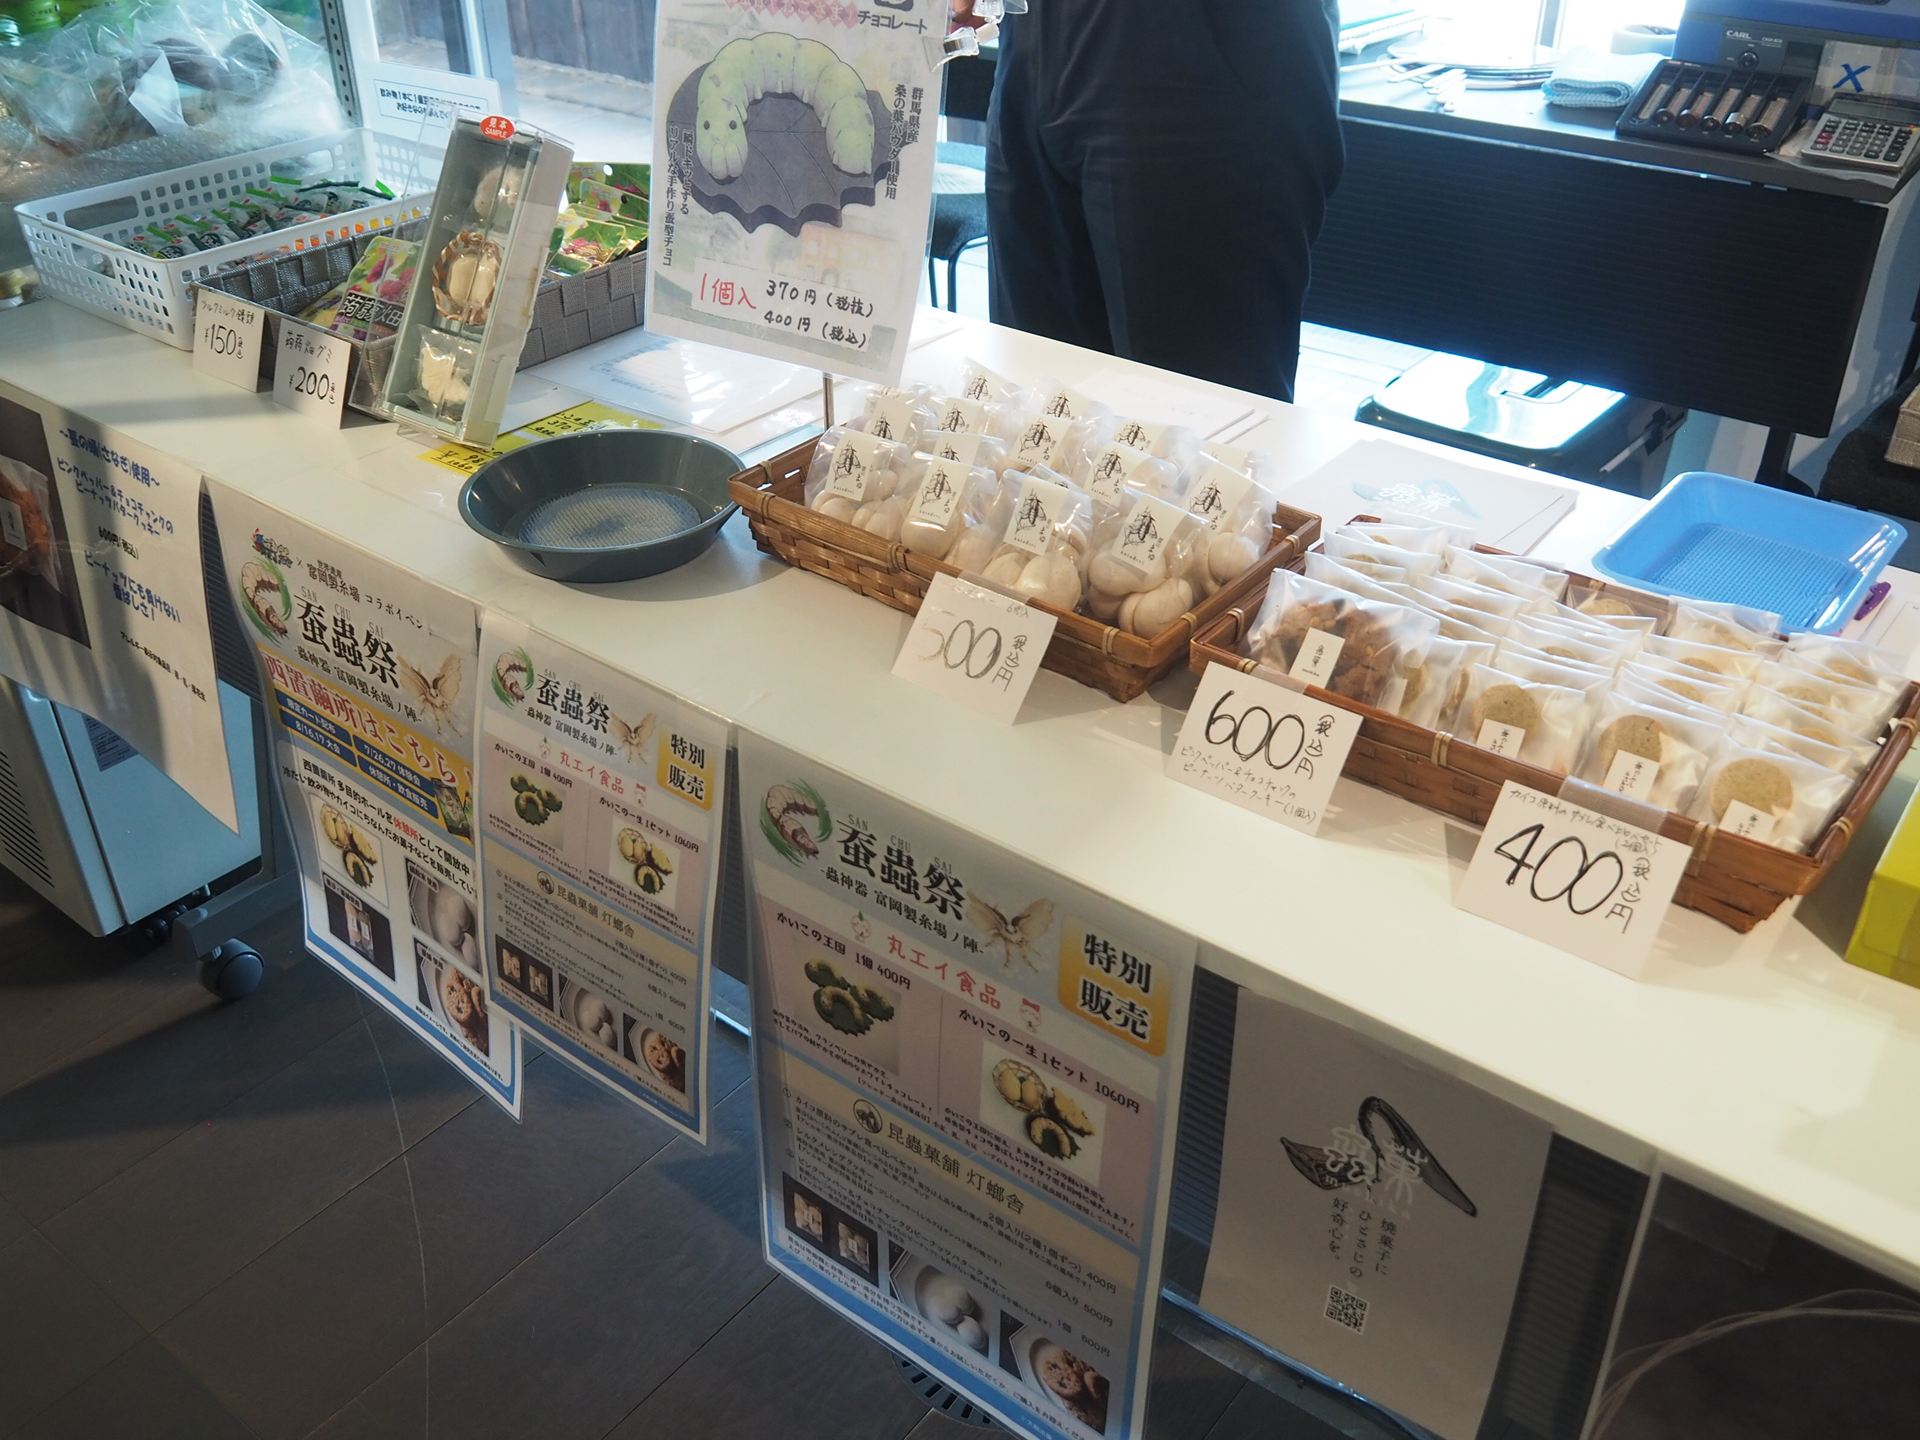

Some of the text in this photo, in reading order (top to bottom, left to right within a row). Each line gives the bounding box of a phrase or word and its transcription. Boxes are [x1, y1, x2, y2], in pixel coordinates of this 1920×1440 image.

[857, 9, 928, 35] チョコレート
[1726, 29, 1752, 40] CARL
[485, 127, 508, 139] SAMPLE
[488, 117, 507, 130] 見本
[885, 83, 907, 200] 桑の葉パウダー使用
[905, 86, 924, 143] 群馬県産
[662, 126, 679, 267] リアルな手作り蚕型チョコ
[680, 128, 694, 216] 一瞬ドキッとする
[766, 279, 817, 307] 370円
[826, 291, 874, 318] (税抜)
[204, 323, 237, 356] ¥150
[763, 310, 867, 349] 400円 (税込)
[288, 366, 330, 400] ¥200
[84, 549, 181, 623] ピーナッツにも負けない
[301, 585, 318, 604] SAN
[368, 620, 384, 640] SAI
[494, 742, 536, 770] かいこの王国
[669, 733, 706, 770] 特別
[1204, 689, 1305, 770] 600
[559, 751, 625, 795] 丸エイ食品
[668, 765, 706, 801] 販売
[847, 812, 954, 874] SAN CHU SAI
[1494, 823, 1624, 915] 400
[776, 910, 912, 991] かいこの王国 1個 400円
[887, 933, 1002, 1011] 丸エイ食品
[1082, 933, 1153, 995] 特別
[1078, 979, 1151, 1043] 販売
[957, 1007, 1141, 1115] かいこの一生 1セット 1060円
[1328, 1195, 1349, 1261] 好奇心を。
[1348, 1208, 1372, 1279] ひとさじの
[1374, 1217, 1398, 1276] 焼菓子に
[1085, 1269, 1117, 1295] 400円
